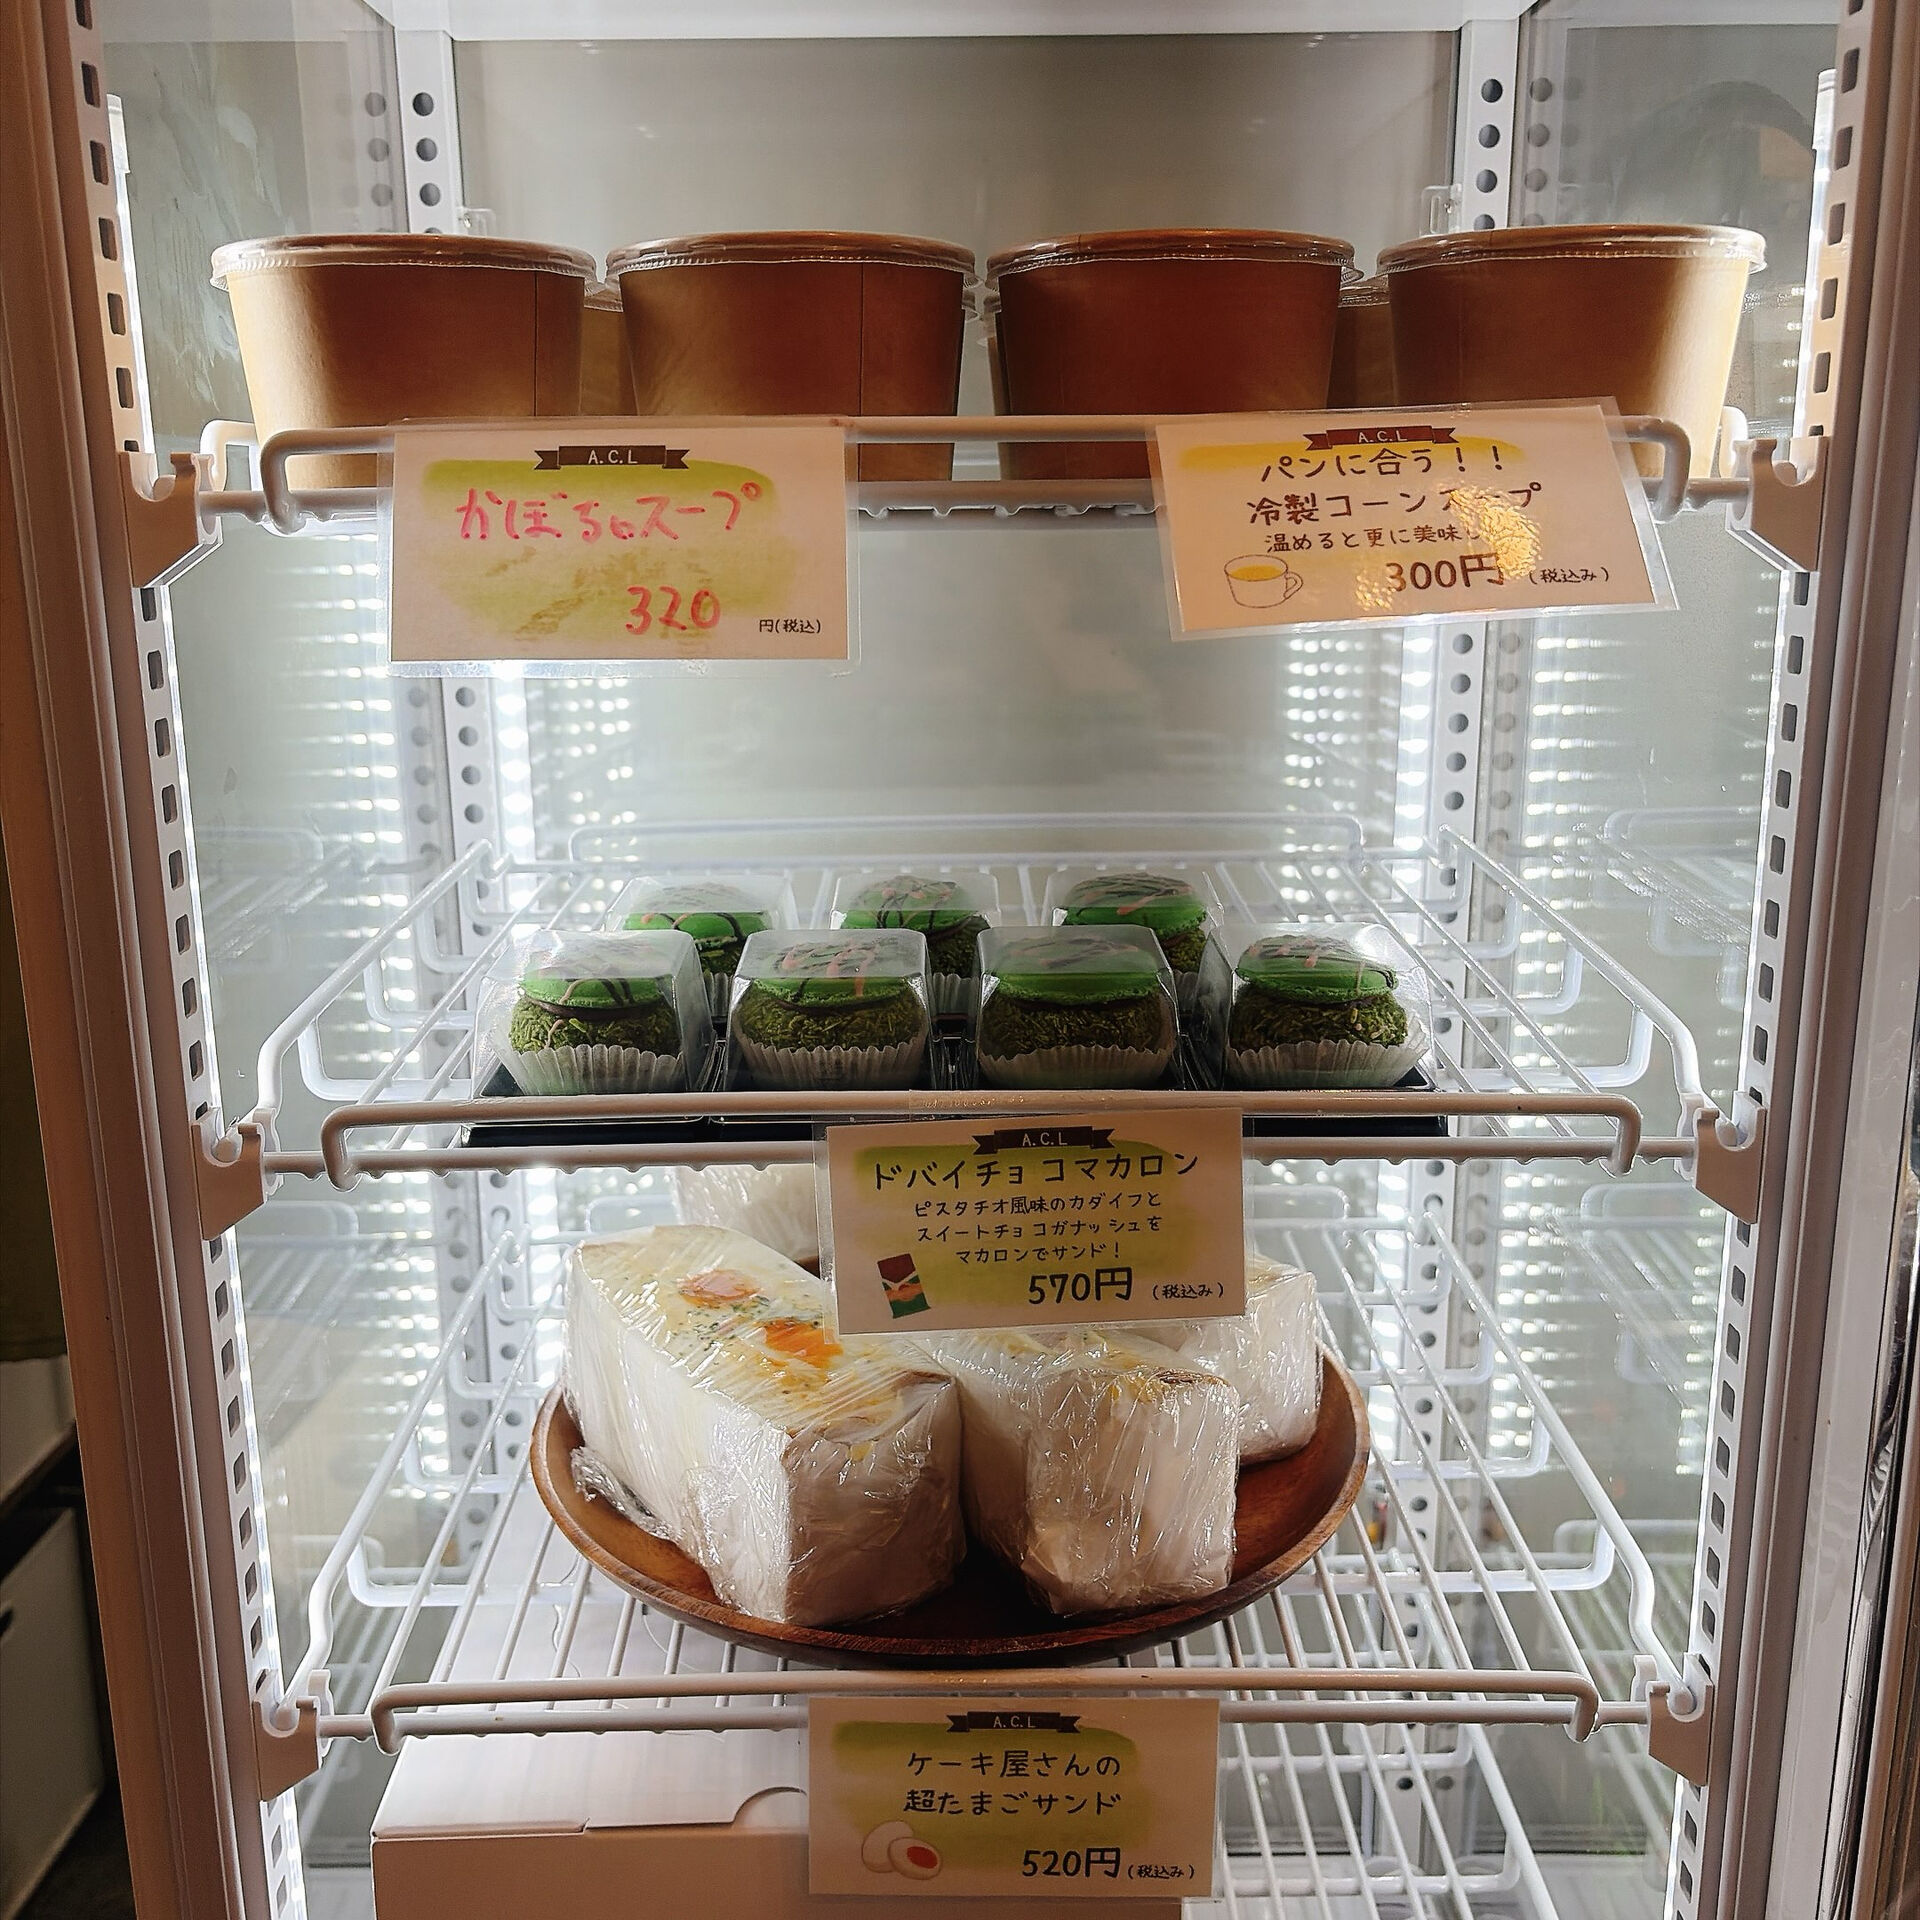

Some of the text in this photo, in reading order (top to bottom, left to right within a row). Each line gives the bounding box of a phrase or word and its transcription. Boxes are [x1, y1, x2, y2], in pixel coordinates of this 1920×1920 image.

[1357, 429, 1408, 444] A.C.L
[587, 449, 639, 465] A.C.L
[1260, 445, 1505, 483] パンに合う！！
[1385, 552, 1610, 593] 300円 （税込み）
[625, 585, 822, 636] 320 円(税込)
[1021, 1131, 1069, 1148] A.C.L
[873, 1152, 1199, 1192] ドバイチョコマカロン
[915, 1190, 1162, 1219] ピスタチオ風味のカダイフと
[916, 1215, 1162, 1243] スイートチョコガナッシュを
[955, 1242, 1121, 1265] マカロンでサンド！
[1028, 1266, 1225, 1305] 570円 （税込み）
[992, 1715, 1037, 1729] A.C.L
[906, 1750, 1122, 1779] ケーキ屋さんの
[903, 1789, 1122, 1816] 超たまごサンド
[1022, 1847, 1196, 1881] 520円 （税込み）
